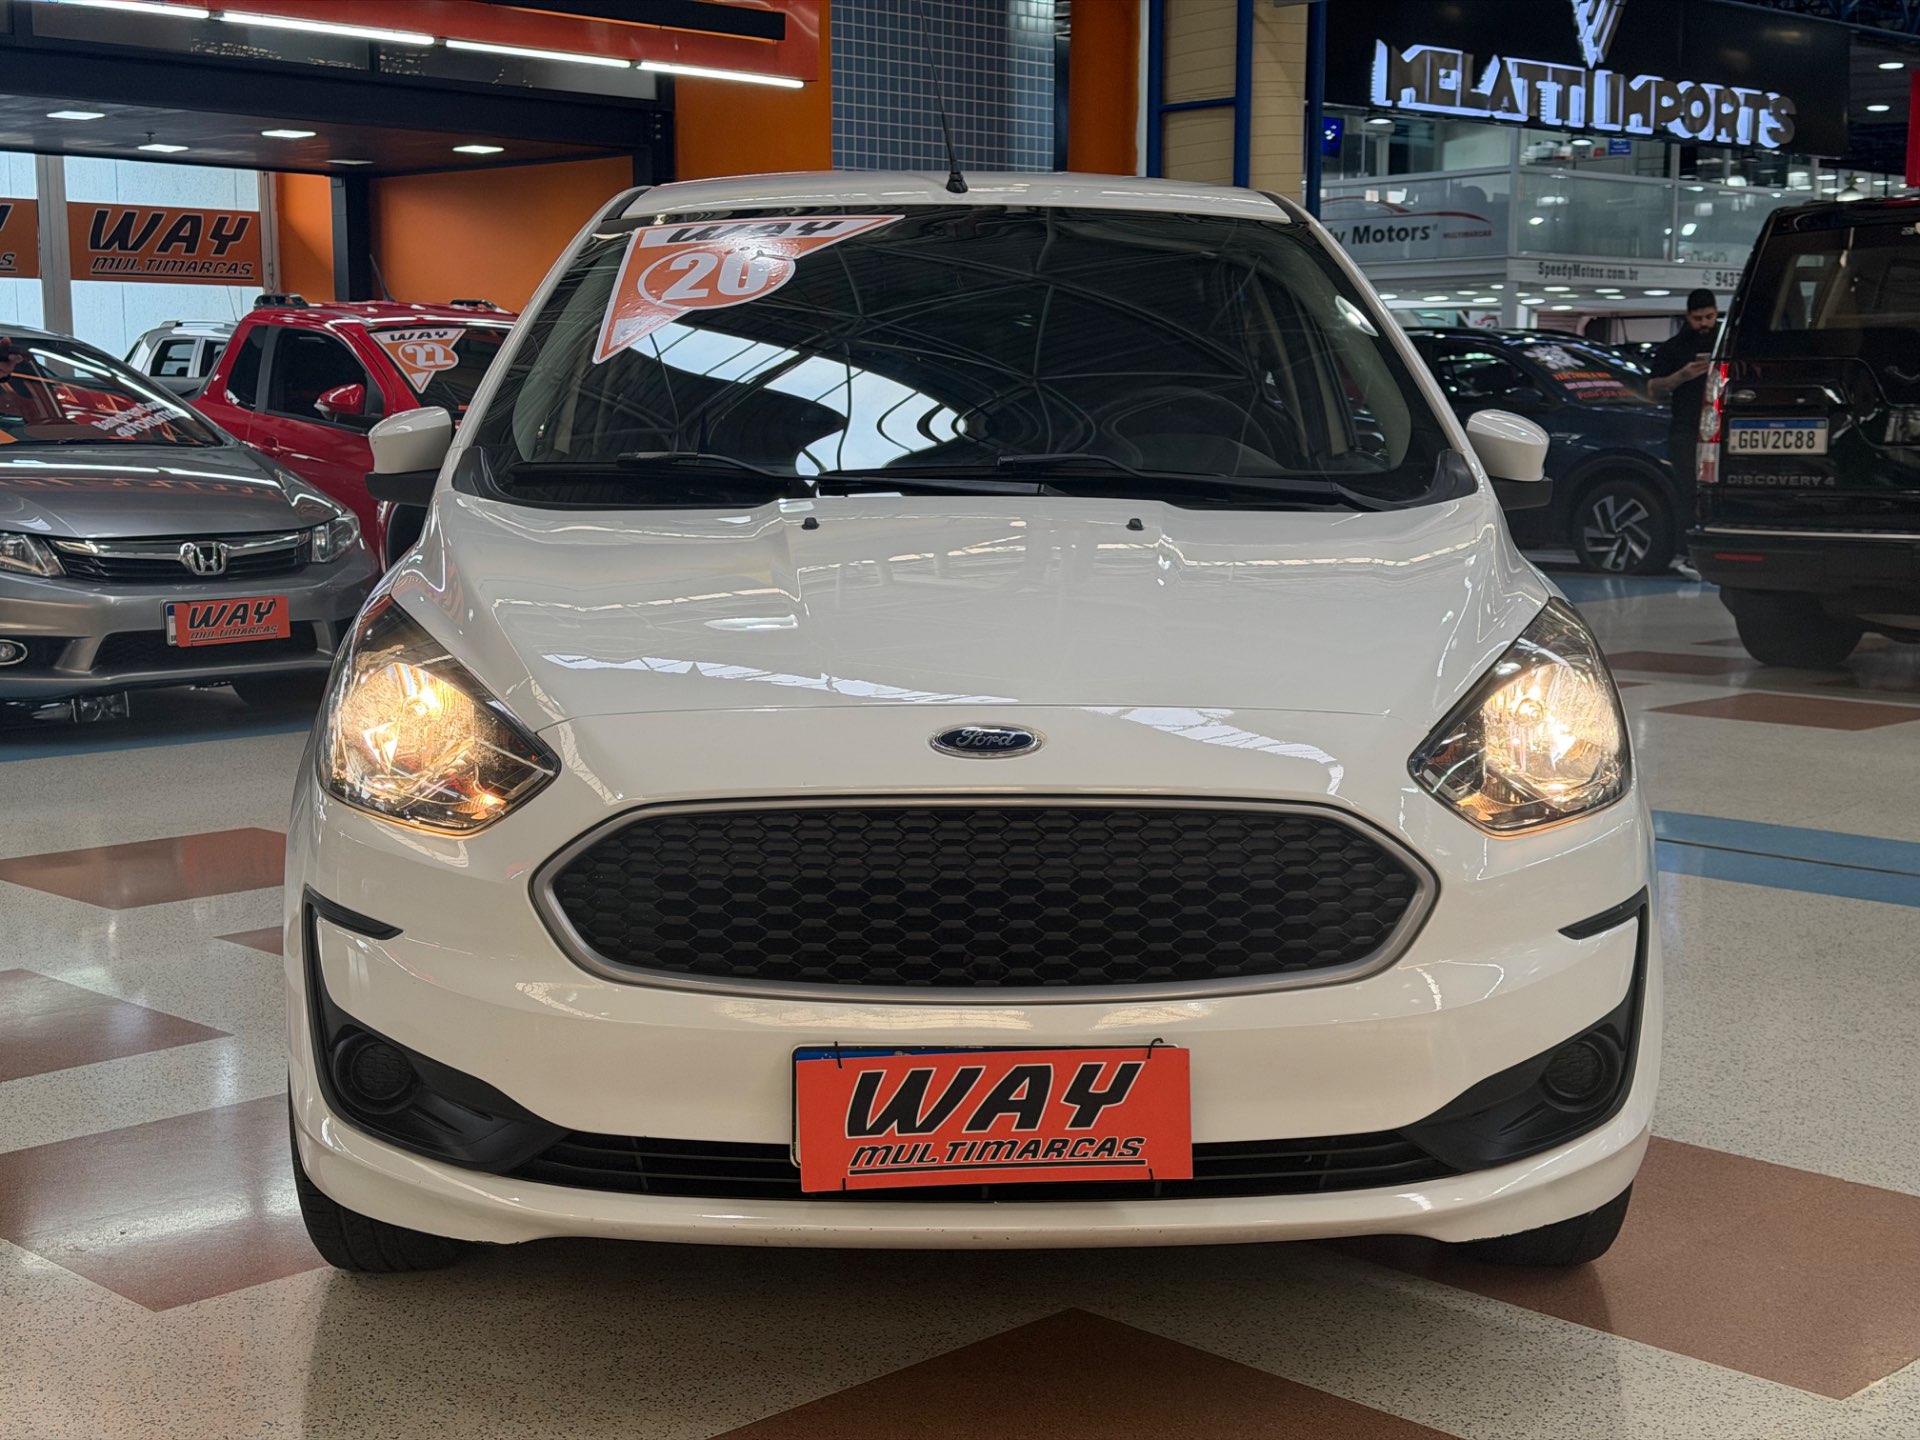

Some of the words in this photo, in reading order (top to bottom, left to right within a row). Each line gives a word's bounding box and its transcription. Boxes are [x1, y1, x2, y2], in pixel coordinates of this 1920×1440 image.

[89, 208, 252, 257] WAY
[666, 220, 846, 244] WAY
[1351, 224, 1430, 245] Motors
[91, 257, 254, 276] MULTIMARCAS
[389, 331, 448, 342] WAY
[404, 344, 454, 367] 22
[1738, 430, 1816, 450] GGV2C88
[1727, 475, 1822, 486] DISCOVERY
[1824, 476, 1836, 486] 4
[188, 600, 276, 630] WAY
[955, 729, 1016, 747] Ford
[845, 1060, 1146, 1139] WAY
[848, 1136, 1147, 1168] MULTIMARCAS
